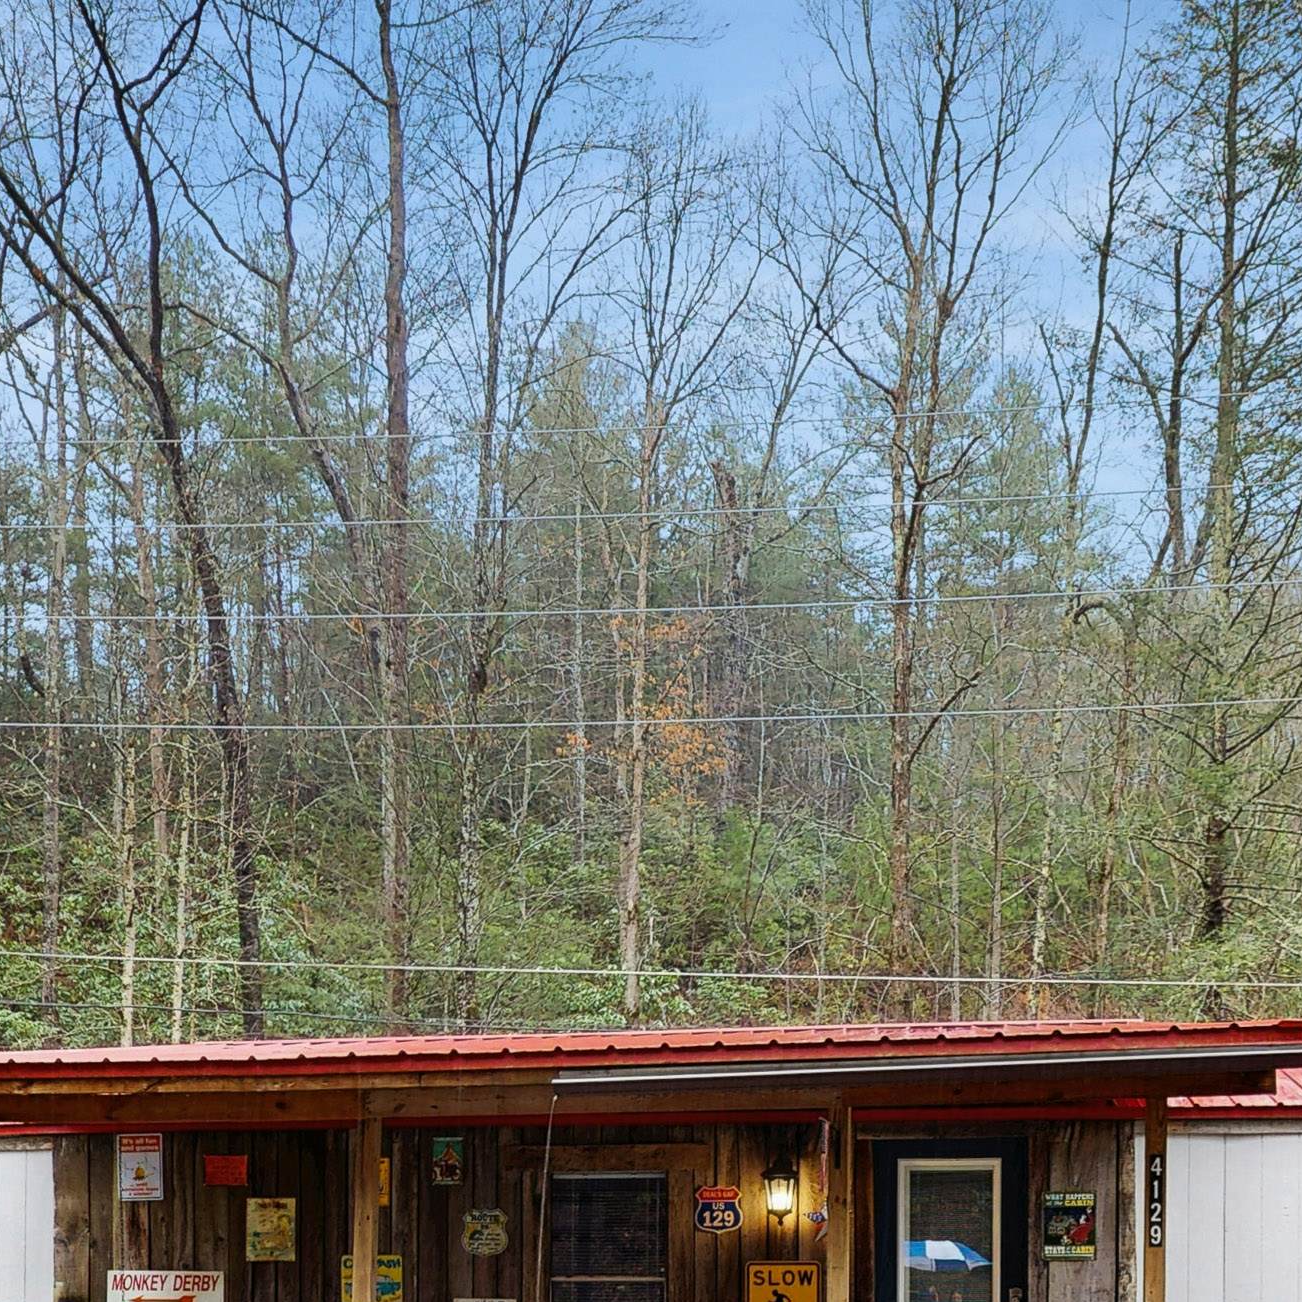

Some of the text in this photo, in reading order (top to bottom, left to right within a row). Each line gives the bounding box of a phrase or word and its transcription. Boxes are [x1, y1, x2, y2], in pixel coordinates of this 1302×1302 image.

[712, 1202, 725, 1210] US
[1151, 1157, 1162, 1245] 4129
[703, 1210, 735, 1227] 129
[112, 1274, 219, 1292] MONKEY DERBY
[753, 1270, 813, 1287] SLOW
